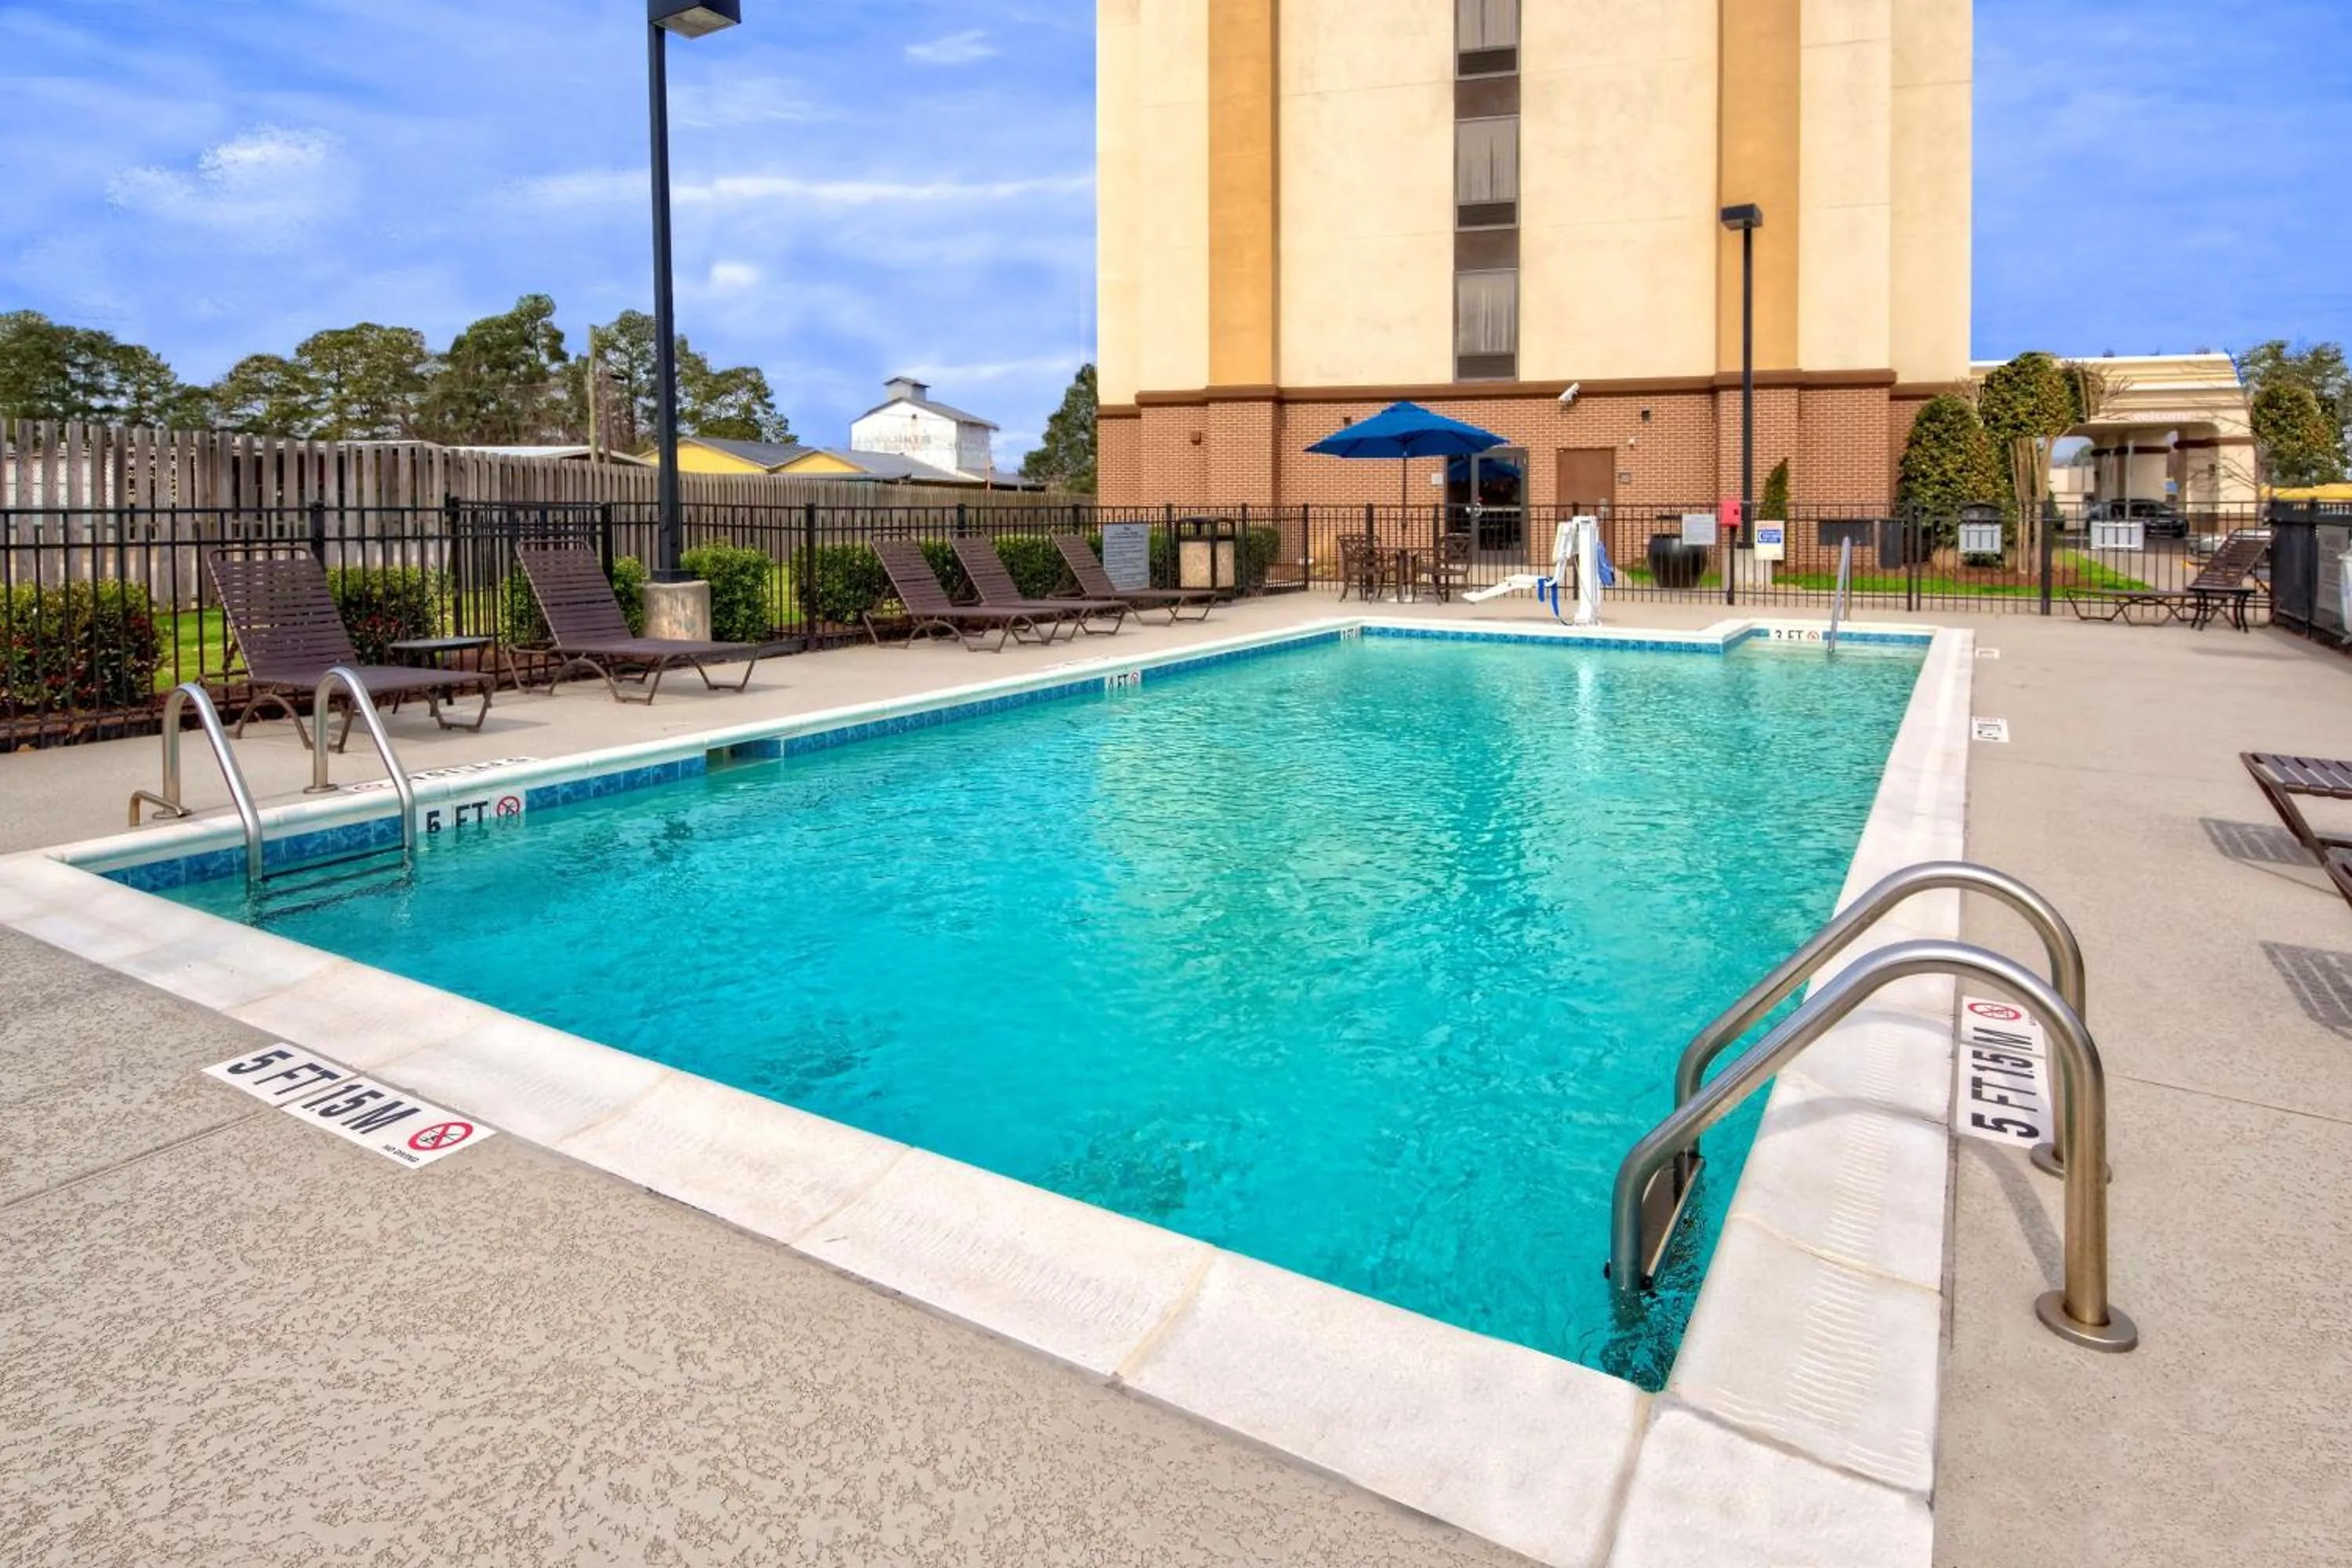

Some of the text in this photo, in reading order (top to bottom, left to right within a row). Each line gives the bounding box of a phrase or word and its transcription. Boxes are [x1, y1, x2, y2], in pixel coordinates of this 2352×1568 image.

[456, 800, 488, 827] FT
[227, 1049, 295, 1076] 5
[252, 1062, 341, 1095] FT
[1970, 1076, 2038, 1112] FT
[1971, 1112, 2039, 1138] 5
